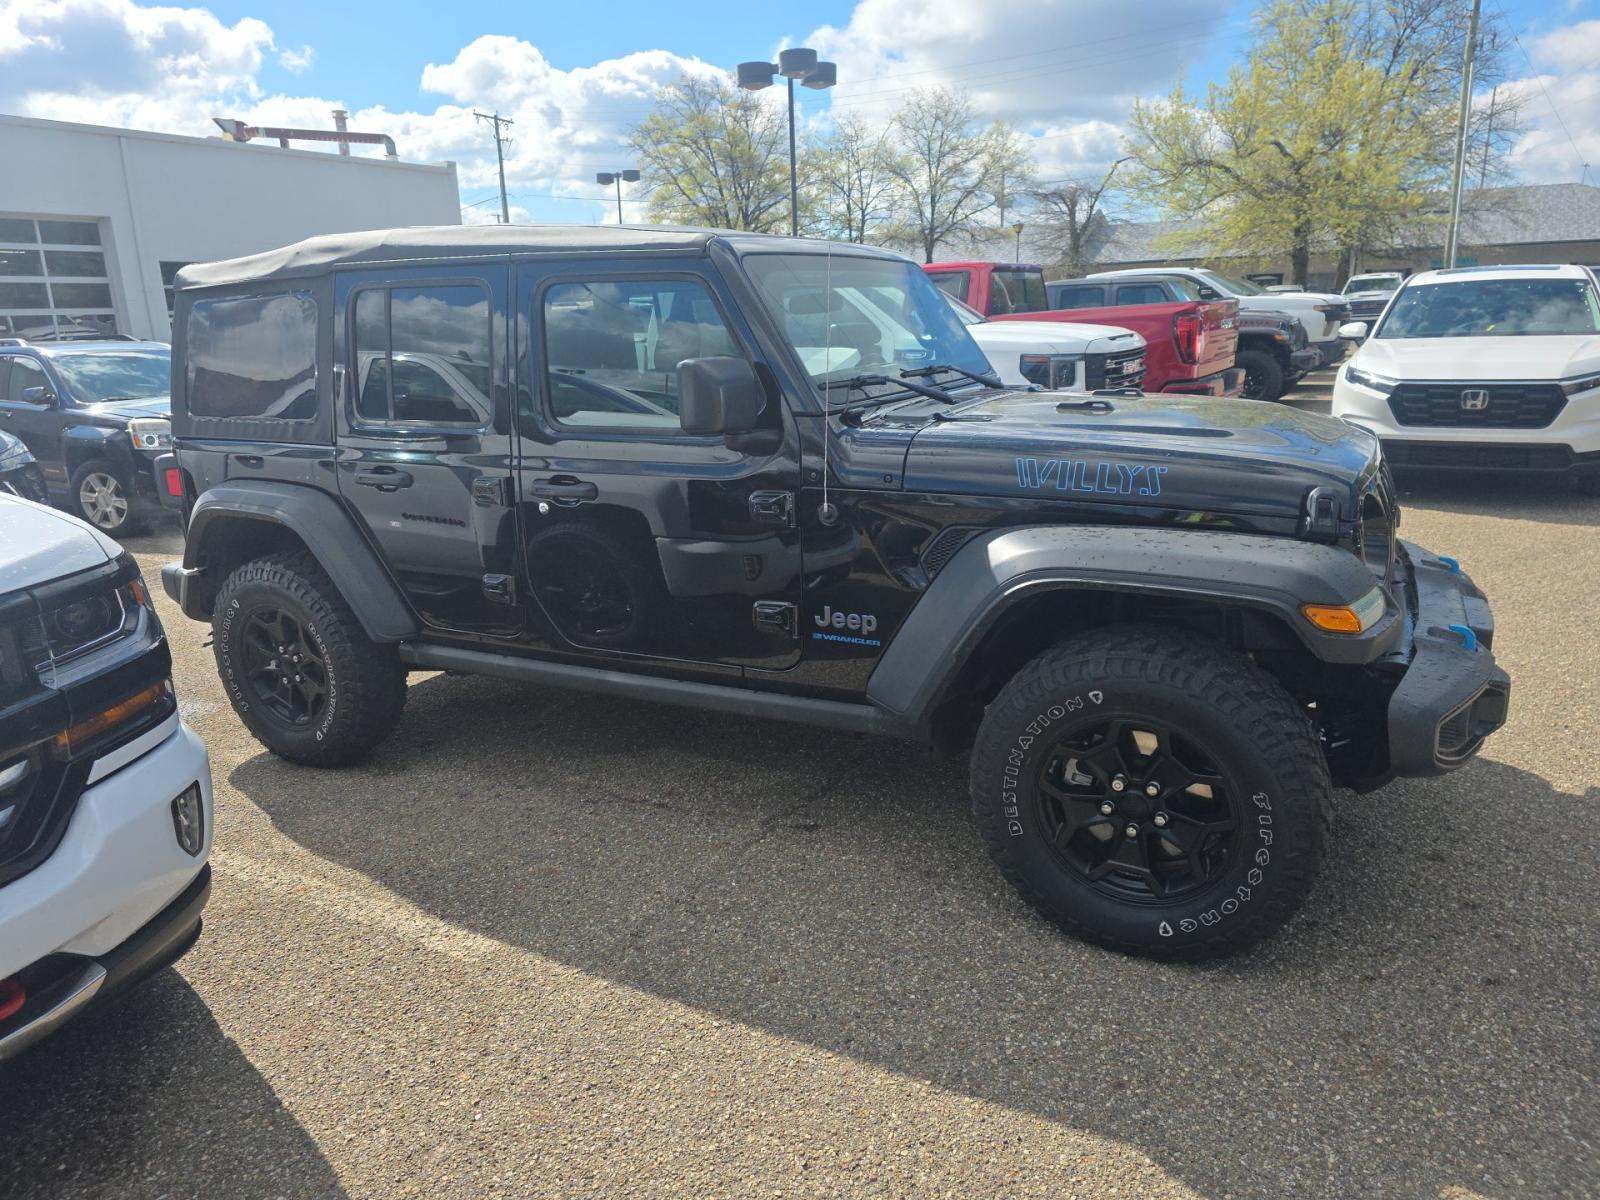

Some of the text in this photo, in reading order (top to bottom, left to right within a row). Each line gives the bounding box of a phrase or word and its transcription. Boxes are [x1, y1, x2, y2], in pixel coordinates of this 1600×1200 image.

[1016, 457, 1168, 497] WILLYS
[814, 605, 878, 635] Jeep
[821, 632, 881, 647] WRANGLER
[1003, 696, 1084, 836] DESTINATION
